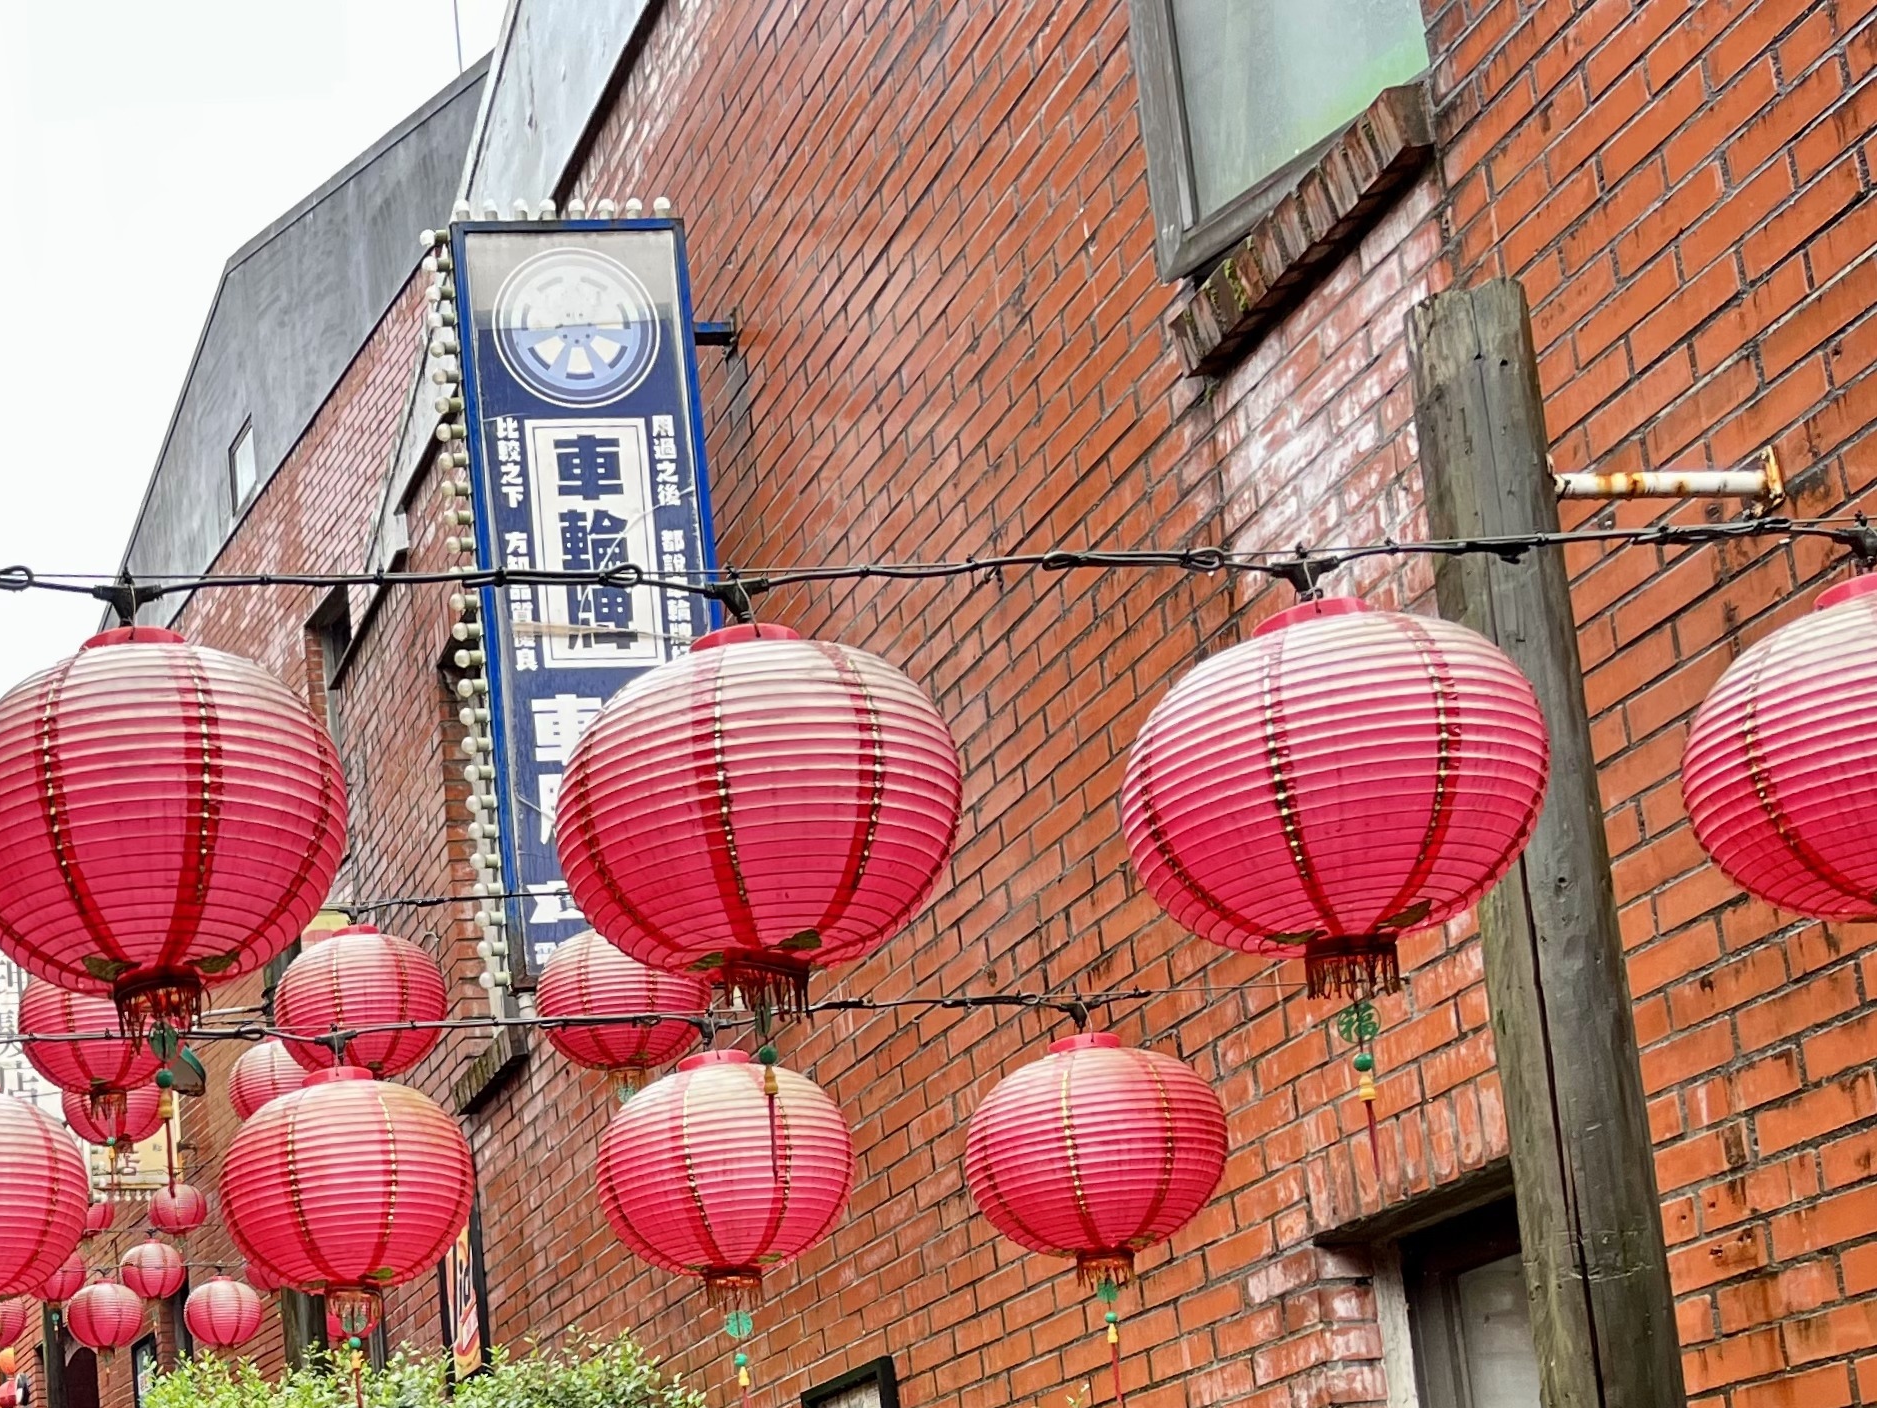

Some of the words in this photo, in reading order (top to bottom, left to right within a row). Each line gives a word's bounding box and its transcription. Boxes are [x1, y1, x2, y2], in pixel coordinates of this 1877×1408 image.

[496, 417, 524, 508] 比較之下
[651, 414, 681, 507] 用過之後
[553, 433, 639, 650] 車輪牌
